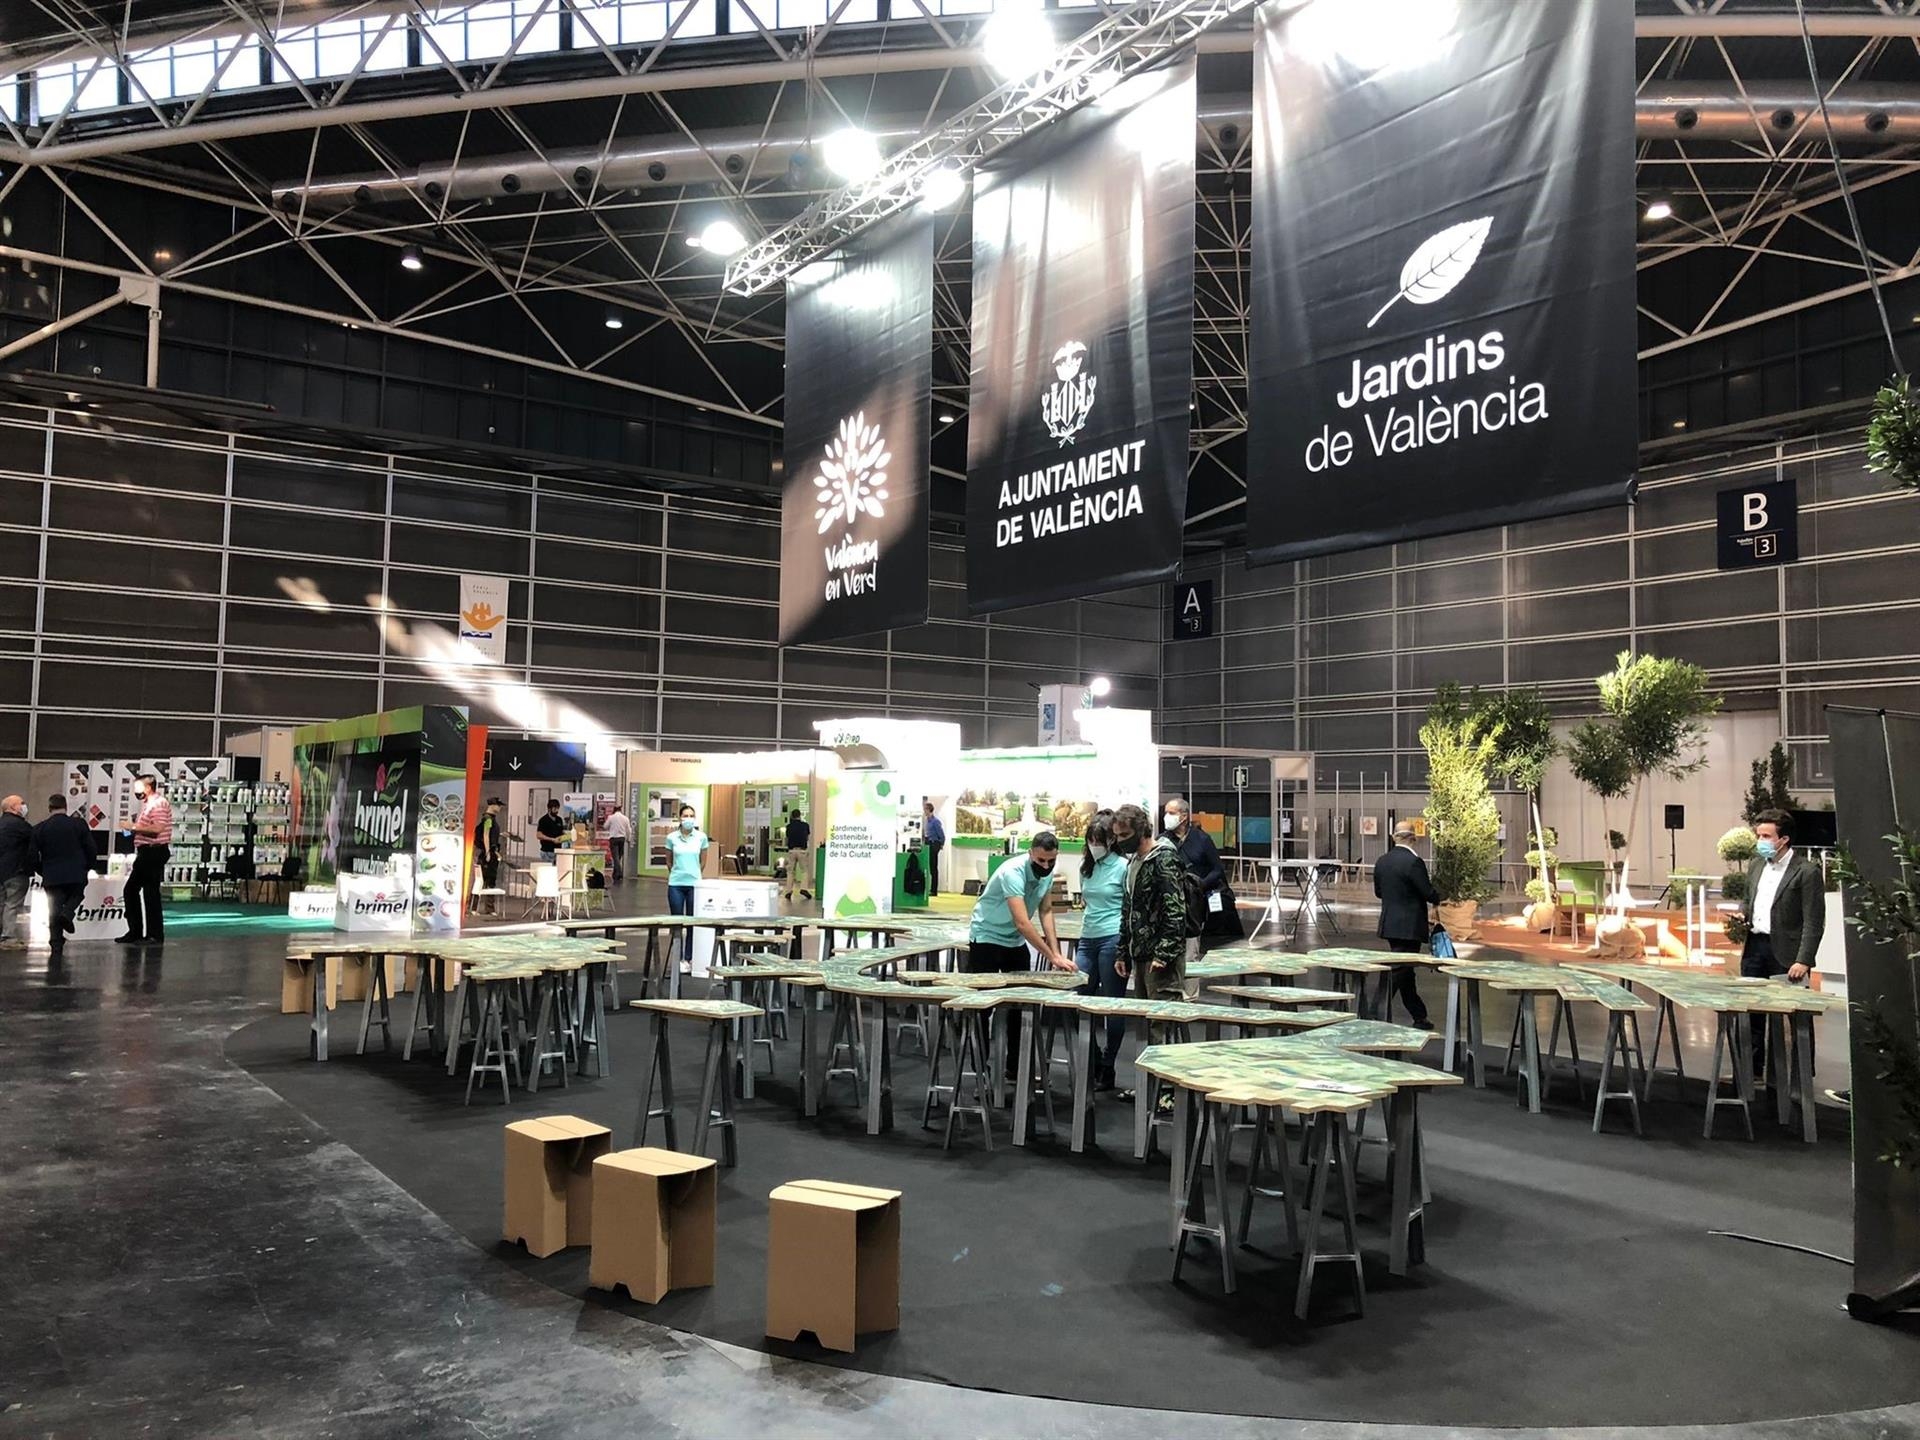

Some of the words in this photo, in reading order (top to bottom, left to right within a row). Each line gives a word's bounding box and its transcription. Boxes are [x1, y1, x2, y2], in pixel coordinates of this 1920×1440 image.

[1336, 330, 1505, 409] Jardins
[1304, 424, 1354, 473] de
[1363, 375, 1549, 457] València
[998, 439, 1146, 510] AJUNTAMENT
[995, 515, 1024, 548] DE
[1029, 484, 1144, 539] VALÈNCIA
[1743, 492, 1769, 532] B
[824, 532, 879, 572] València
[1760, 538, 1770, 554] 3
[825, 578, 841, 601] en
[843, 562, 877, 597] Verd
[1183, 587, 1201, 614] A
[1193, 619, 1199, 630] 3
[353, 788, 408, 848] brimel
[829, 833, 869, 841] Sostenible
[829, 841, 889, 850] Renaturalització
[829, 850, 838, 858] de
[840, 850, 848, 858] la
[849, 850, 872, 858] Ciutat
[354, 898, 409, 915] brimel
